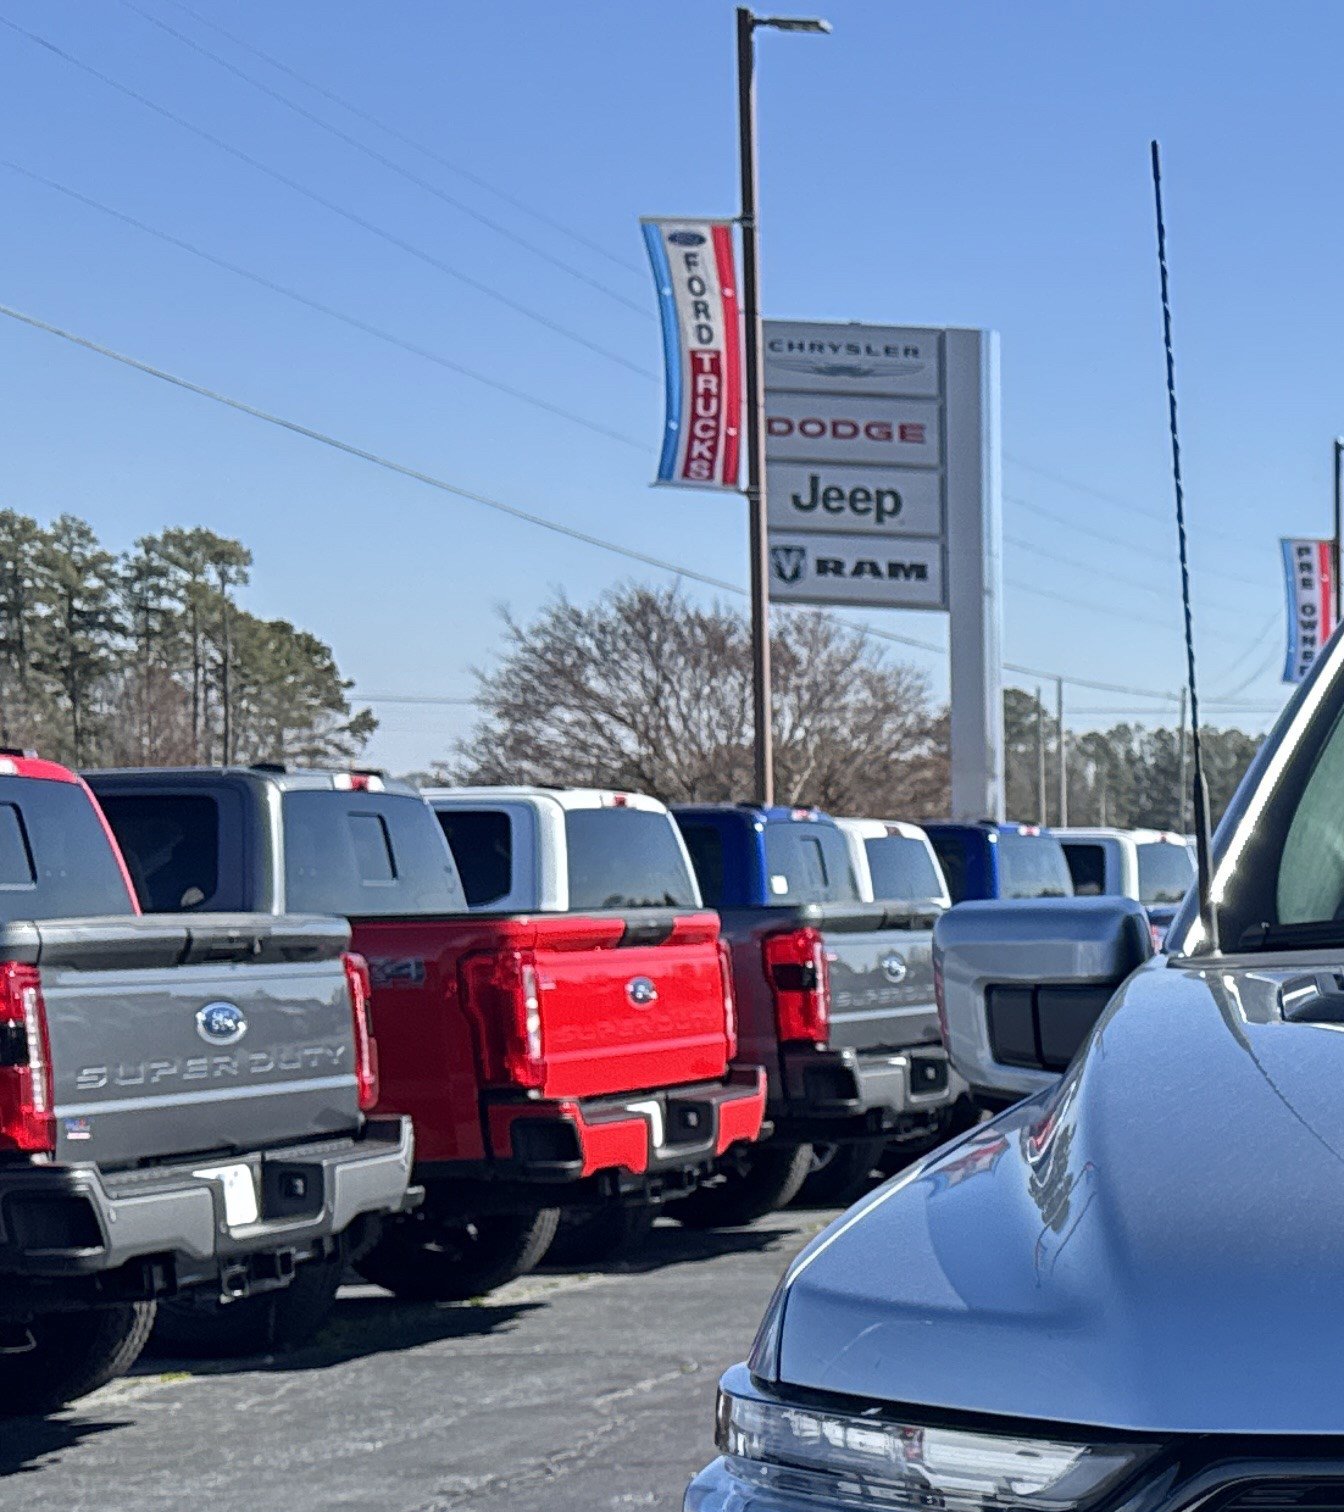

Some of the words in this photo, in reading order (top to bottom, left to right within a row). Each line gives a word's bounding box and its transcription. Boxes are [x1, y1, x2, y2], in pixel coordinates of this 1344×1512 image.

[684, 252, 714, 345] FORD
[768, 339, 920, 358] CHRYSLER
[690, 352, 718, 480] TRUCKS
[766, 416, 926, 444] DODGE
[791, 473, 902, 524] Jeep
[816, 559, 928, 580] RAM
